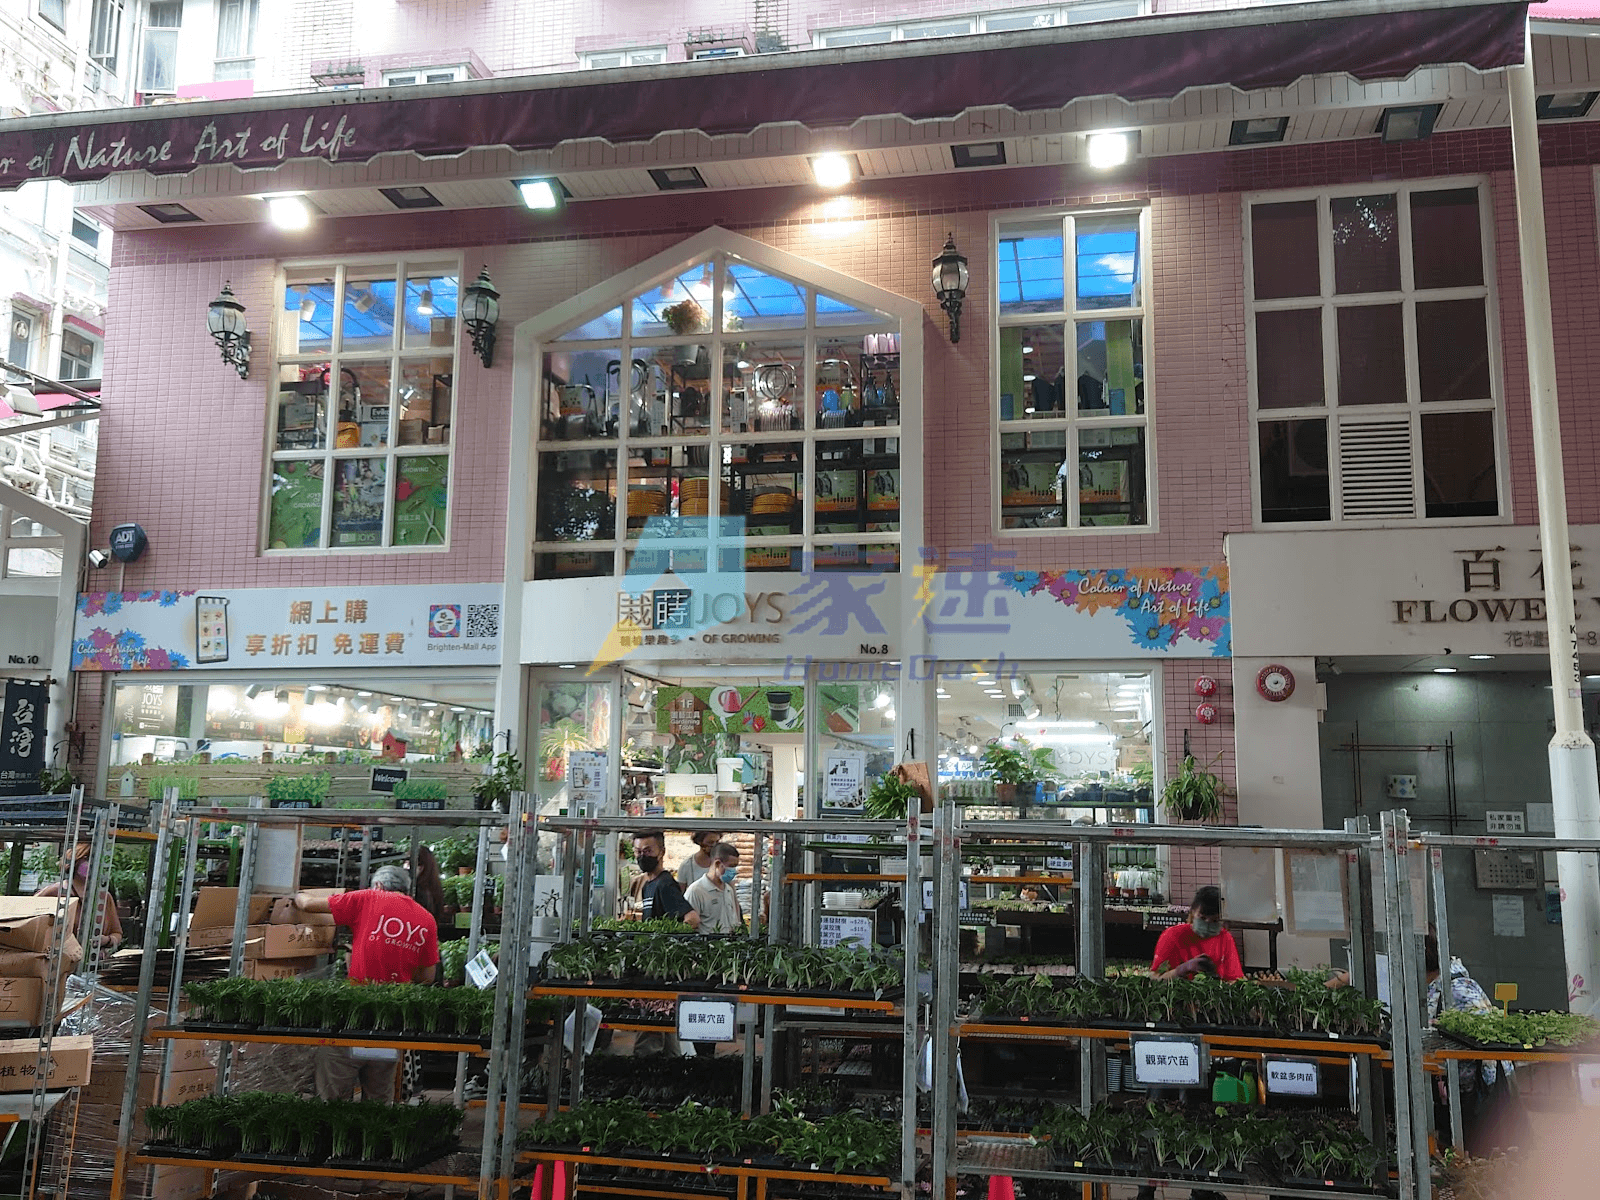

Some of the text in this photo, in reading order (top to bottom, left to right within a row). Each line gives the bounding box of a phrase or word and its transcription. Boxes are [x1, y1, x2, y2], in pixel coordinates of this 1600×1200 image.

[28, 143, 54, 177] of
[63, 130, 172, 175] Nature
[192, 121, 251, 164] Art
[259, 123, 290, 159] of
[300, 115, 356, 161] Life
[115, 530, 135, 543] ADT
[1078, 577, 1193, 598] Colour of Nature
[289, 600, 368, 625] 網上購
[695, 591, 788, 625] JOYS
[1141, 599, 1210, 618] Art of Life
[245, 633, 406, 656] 享折扣 免運費
[702, 634, 781, 644] OF GROWING
[76, 643, 103, 655] Colour
[480, 643, 497, 652] App
[859, 643, 890, 656] No.8
[681, 698, 694, 709] 1F
[9, 698, 35, 758] 台灣
[371, 914, 428, 947] JOYS
[688, 1013, 726, 1024] 觀葉穴苗
[1145, 1054, 1189, 1067] 觀葉穴苗
[1271, 1071, 1314, 1082] 軟盆多肉苗
